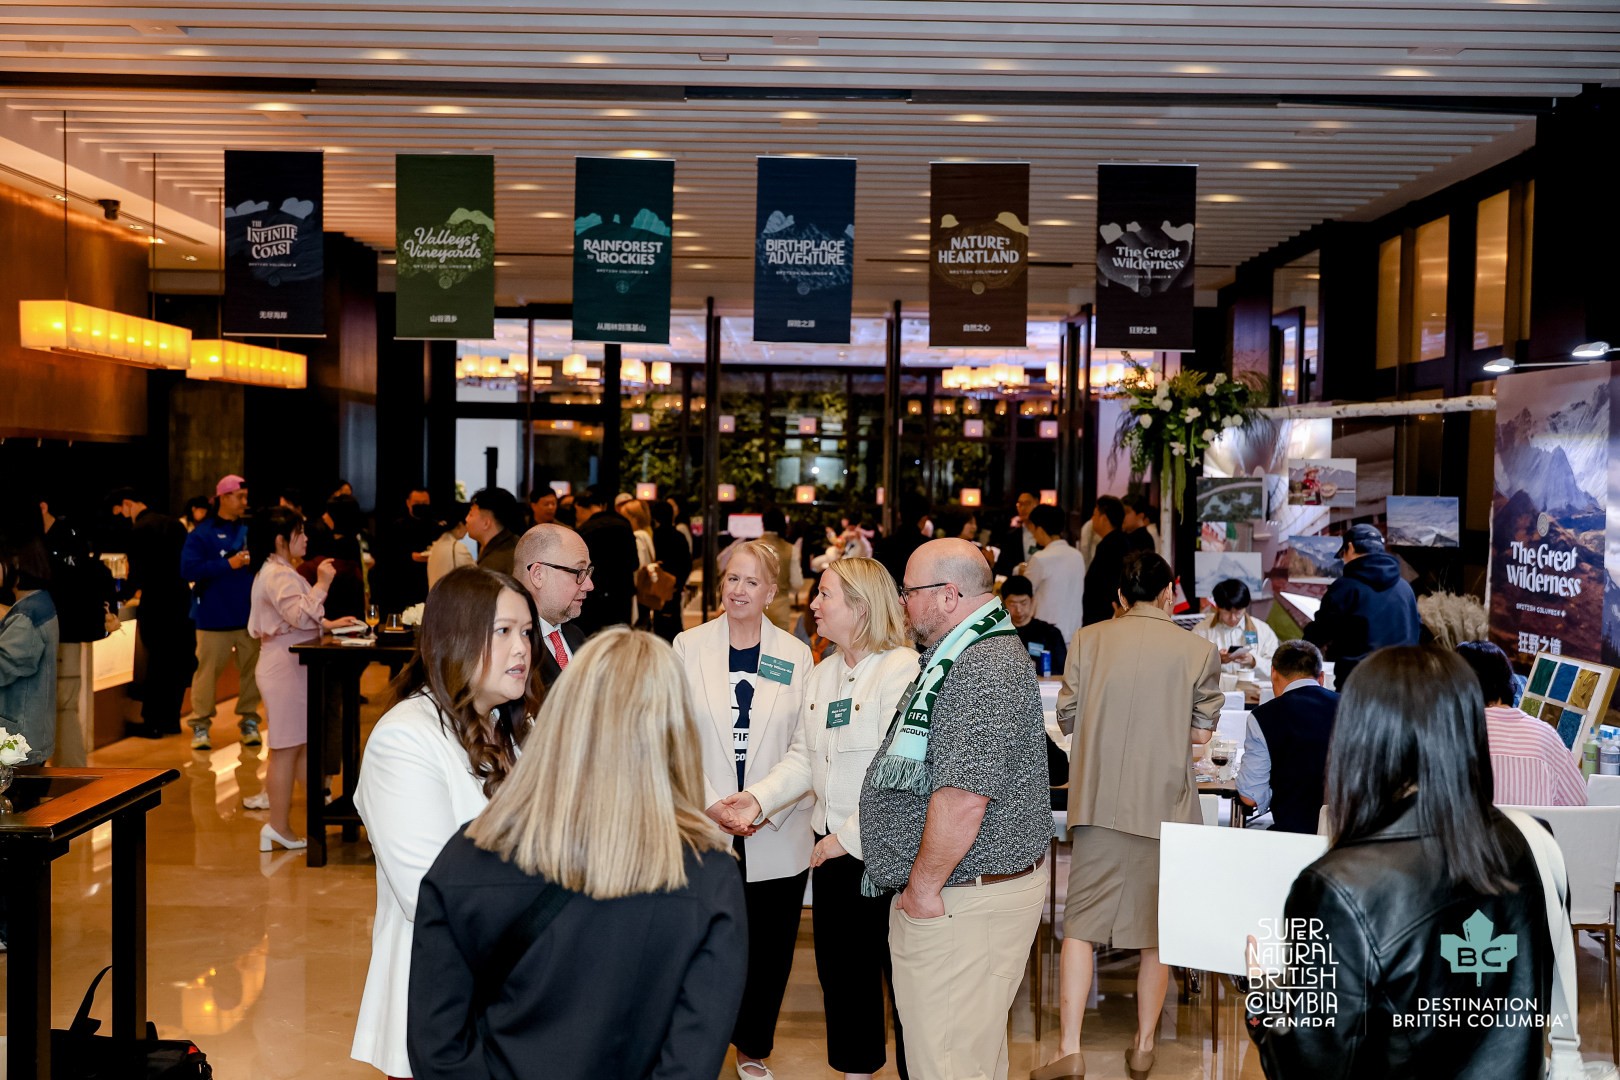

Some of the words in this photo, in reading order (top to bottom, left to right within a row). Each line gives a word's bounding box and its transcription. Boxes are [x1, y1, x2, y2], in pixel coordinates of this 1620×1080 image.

[247, 224, 298, 243] INFINITE
[414, 227, 471, 249] Valleys
[251, 240, 293, 259] COAST
[403, 239, 481, 263] Vineyards
[583, 239, 663, 254] RAINFOREST
[765, 239, 845, 254] BIRTHPLACE
[1116, 246, 1142, 258] The
[1143, 246, 1181, 259] Great
[596, 251, 655, 265] ROCKIES
[768, 250, 845, 265] ADVENTURE
[938, 250, 1020, 264] HEARTLAND
[1112, 256, 1185, 270] Wilderness
[1510, 541, 1537, 567] The
[1537, 543, 1578, 573] Great
[1506, 564, 1582, 598] Wilderness
[1516, 602, 1536, 612] BRITISH
[1536, 606, 1561, 617] COLUMBIA
[907, 711, 929, 723] FIFA
[733, 732, 749, 741] FIF
